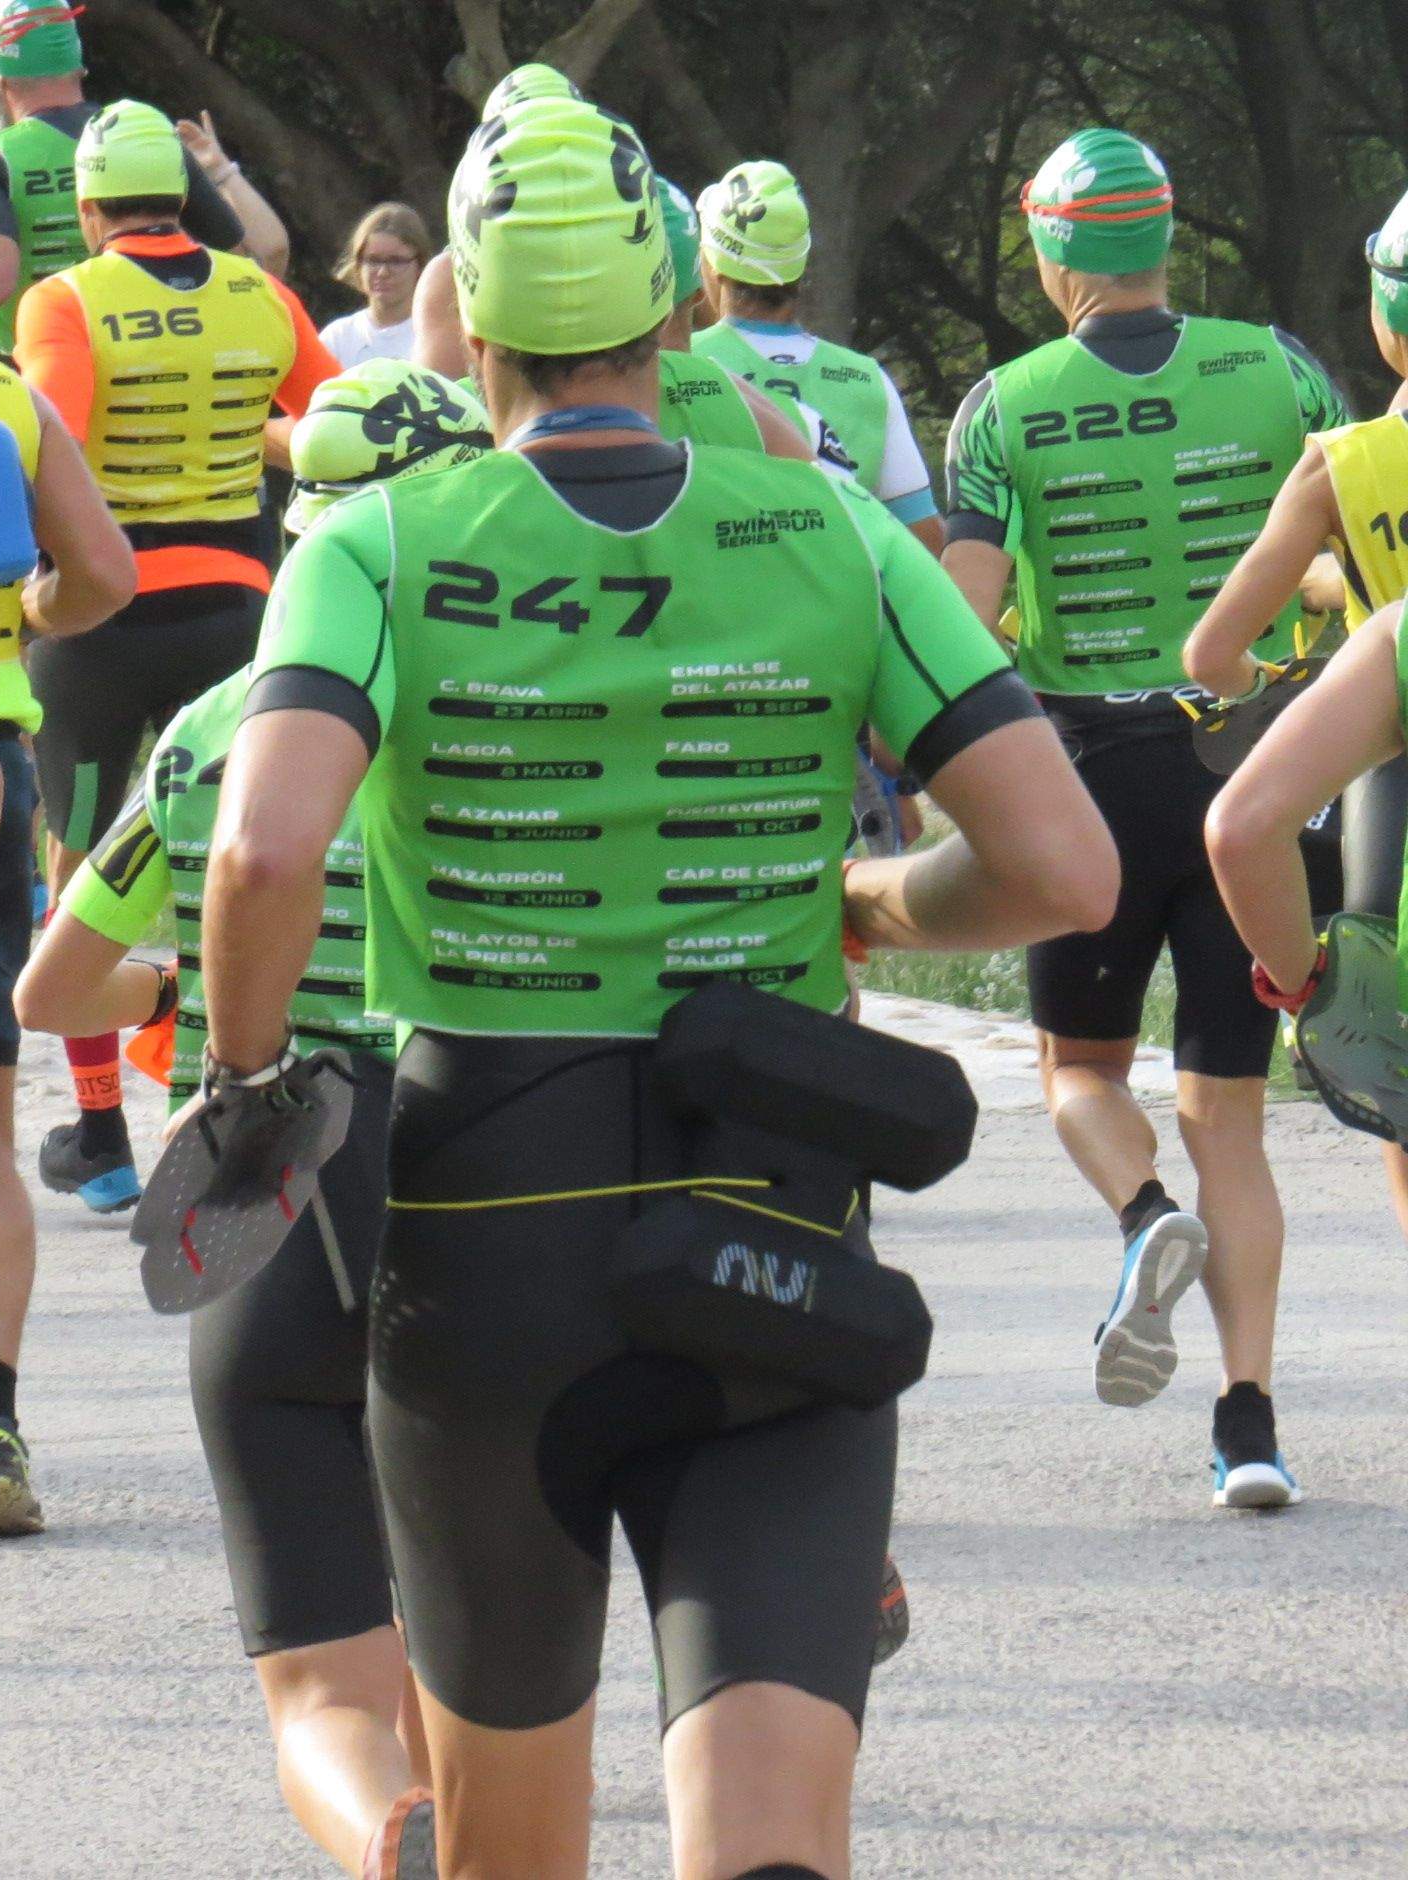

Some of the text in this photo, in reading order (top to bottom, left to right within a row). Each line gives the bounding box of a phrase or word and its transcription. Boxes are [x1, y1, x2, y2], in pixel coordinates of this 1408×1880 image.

[102, 306, 204, 341] 136
[1197, 354, 1267, 370] SWIMRUN
[1020, 397, 1178, 450] 228
[1173, 443, 1239, 461] EMBALSE
[715, 516, 826, 538] SWIMRUN
[717, 533, 779, 550] SERIES
[423, 559, 673, 638] 247
[670, 661, 782, 678] EMBALSE
[440, 680, 544, 698] C. BRAVA
[671, 678, 811, 696] DEL ATAZAR
[763, 700, 809, 714] SEP
[432, 741, 514, 757] LAGOA
[665, 741, 731, 754] FARO
[522, 765, 588, 777] MAYO
[430, 803, 560, 822] C. AZAHAR
[665, 797, 821, 817] FUERTEVENTURA
[513, 827, 589, 840] JUNIO
[763, 818, 802, 833] OCT
[666, 858, 827, 880] CAP DE CREUS
[512, 893, 587, 907] JUNIO
[430, 928, 577, 949] PELAYOS DE
[665, 936, 733, 950] CABO
[464, 949, 549, 965] PRESA
[665, 952, 746, 967] PALOS
[512, 976, 583, 989] JUNIO
